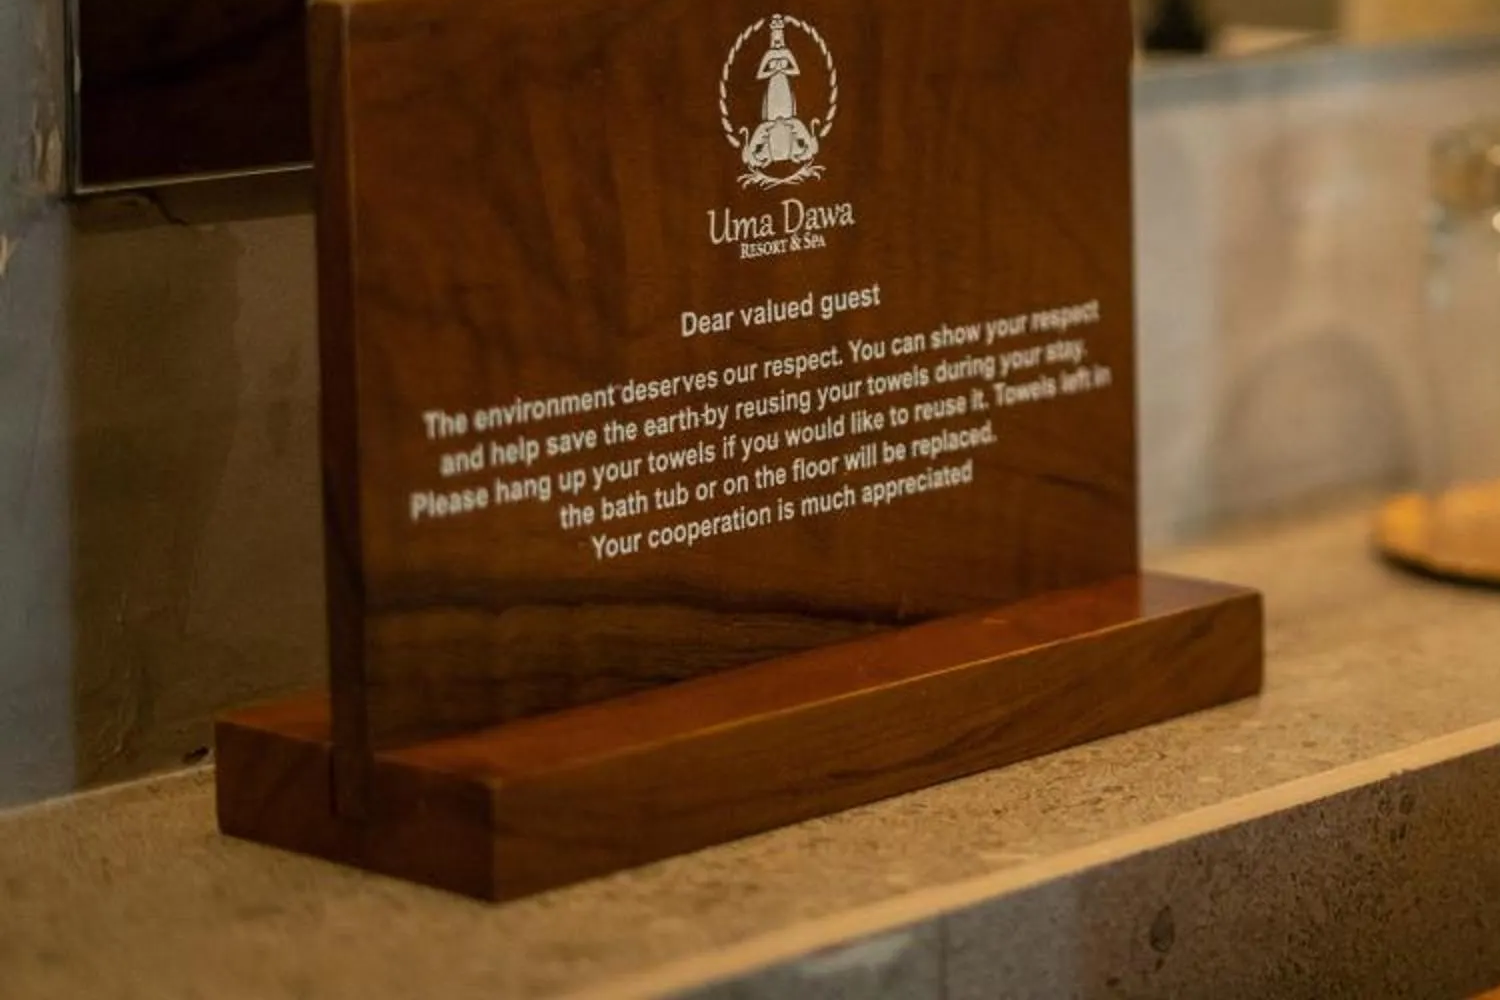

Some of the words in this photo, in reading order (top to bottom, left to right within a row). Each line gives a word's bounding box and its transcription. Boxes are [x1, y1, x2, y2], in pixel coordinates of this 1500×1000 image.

[707, 207, 776, 245] Uma
[781, 198, 856, 234] Dawa
[790, 234, 801, 250] &
[681, 310, 734, 337] Dear
[740, 292, 813, 327] valued
[820, 283, 880, 320] guest
[422, 409, 468, 440] The
[474, 384, 615, 431] environment
[621, 370, 718, 402] deserves
[723, 363, 757, 386] our
[764, 345, 843, 379] respect.
[849, 338, 885, 363] You
[891, 333, 925, 356] can
[930, 322, 981, 349] show
[985, 314, 1028, 345] your
[1029, 299, 1100, 333] respect
[440, 443, 484, 477] and
[490, 437, 540, 468] help
[546, 428, 597, 455] save
[603, 419, 637, 446] the
[735, 389, 811, 420] reusing
[817, 380, 862, 410] your
[867, 365, 929, 395] towels
[935, 355, 995, 383] during
[1000, 346, 1042, 377] your
[1045, 339, 1088, 364] stay.
[411, 487, 488, 521] Please
[495, 475, 551, 504] hang
[558, 468, 586, 495] up
[592, 459, 642, 491] your
[648, 441, 715, 473] towels
[723, 435, 736, 459] if
[741, 431, 778, 462] you
[785, 415, 845, 446] would
[851, 410, 885, 434] like
[889, 406, 909, 426] to
[914, 395, 967, 422] reuse
[970, 388, 989, 411] it.
[993, 375, 1056, 407] Towels
[1060, 367, 1091, 394] left
[1093, 365, 1112, 389] in
[560, 503, 594, 529] the
[601, 491, 648, 521] bath
[654, 481, 688, 509] tub
[695, 480, 717, 501] or
[723, 475, 748, 496] on
[755, 464, 787, 489] the
[792, 456, 839, 482] floor
[843, 442, 877, 471] will
[882, 441, 907, 463] be
[911, 420, 997, 459] replaced.
[591, 533, 642, 559] Your
[648, 505, 771, 549] cooperation
[778, 498, 794, 521] is
[801, 483, 855, 517] much
[861, 458, 974, 506] appreciated
